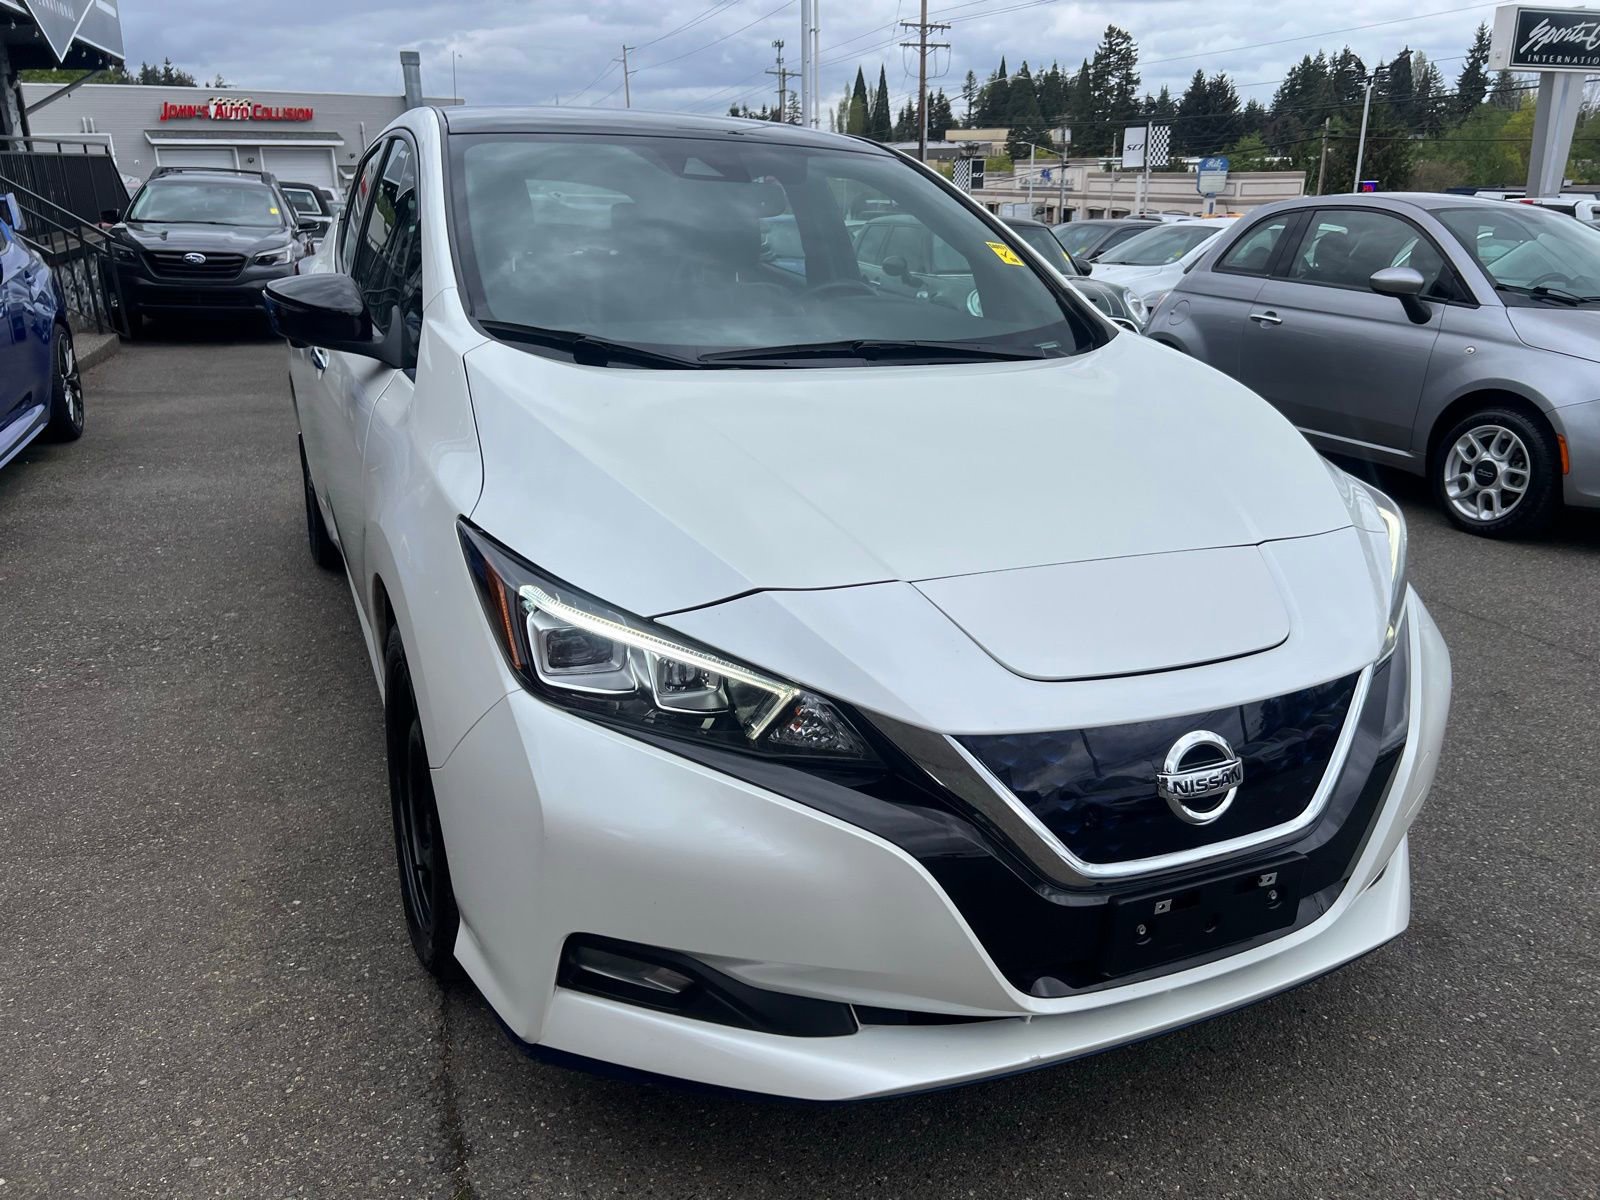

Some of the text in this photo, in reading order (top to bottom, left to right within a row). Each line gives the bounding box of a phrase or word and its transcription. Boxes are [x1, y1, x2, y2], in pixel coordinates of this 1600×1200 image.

[160, 102, 314, 121] JOHN'S AUTO COLLISION
[1125, 143, 1145, 151] SCI
[1172, 767, 1241, 794] NISSAN
